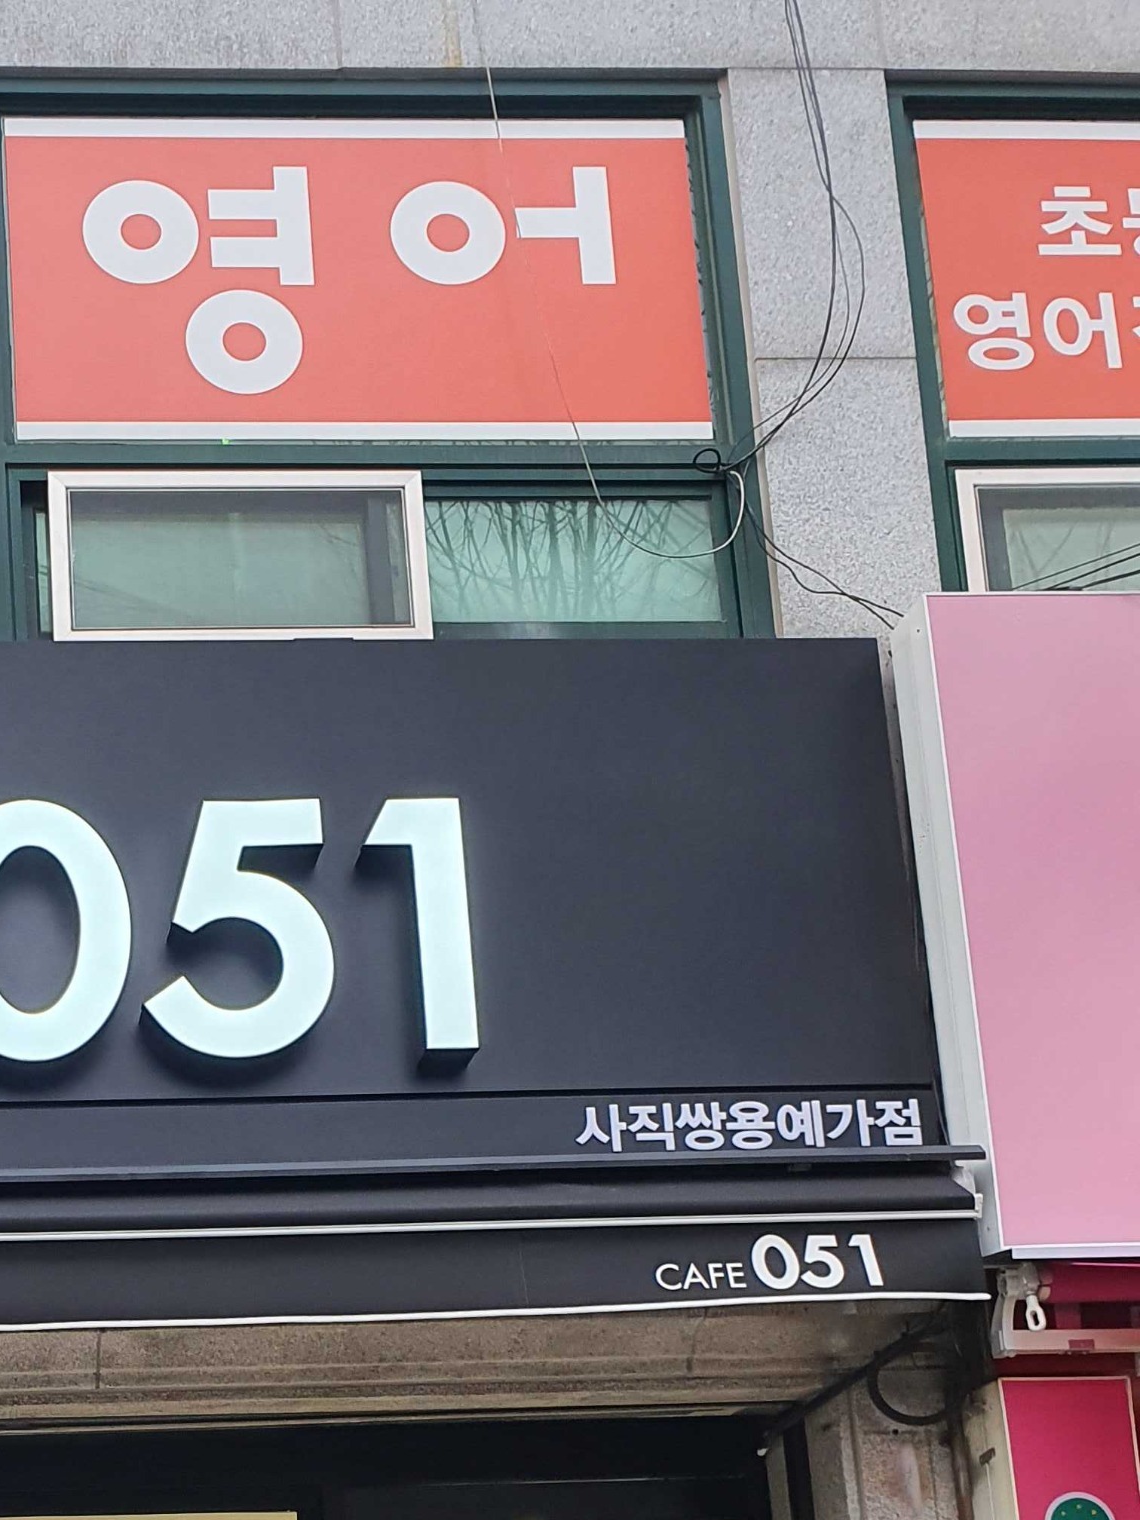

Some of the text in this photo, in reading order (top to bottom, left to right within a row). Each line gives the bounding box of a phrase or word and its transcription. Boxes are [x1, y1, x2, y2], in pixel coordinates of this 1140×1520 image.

[953, 292, 1140, 371] 영어
[576, 1098, 923, 1153] 사직쌍용예가점
[655, 1233, 885, 1290] CAFE 051
